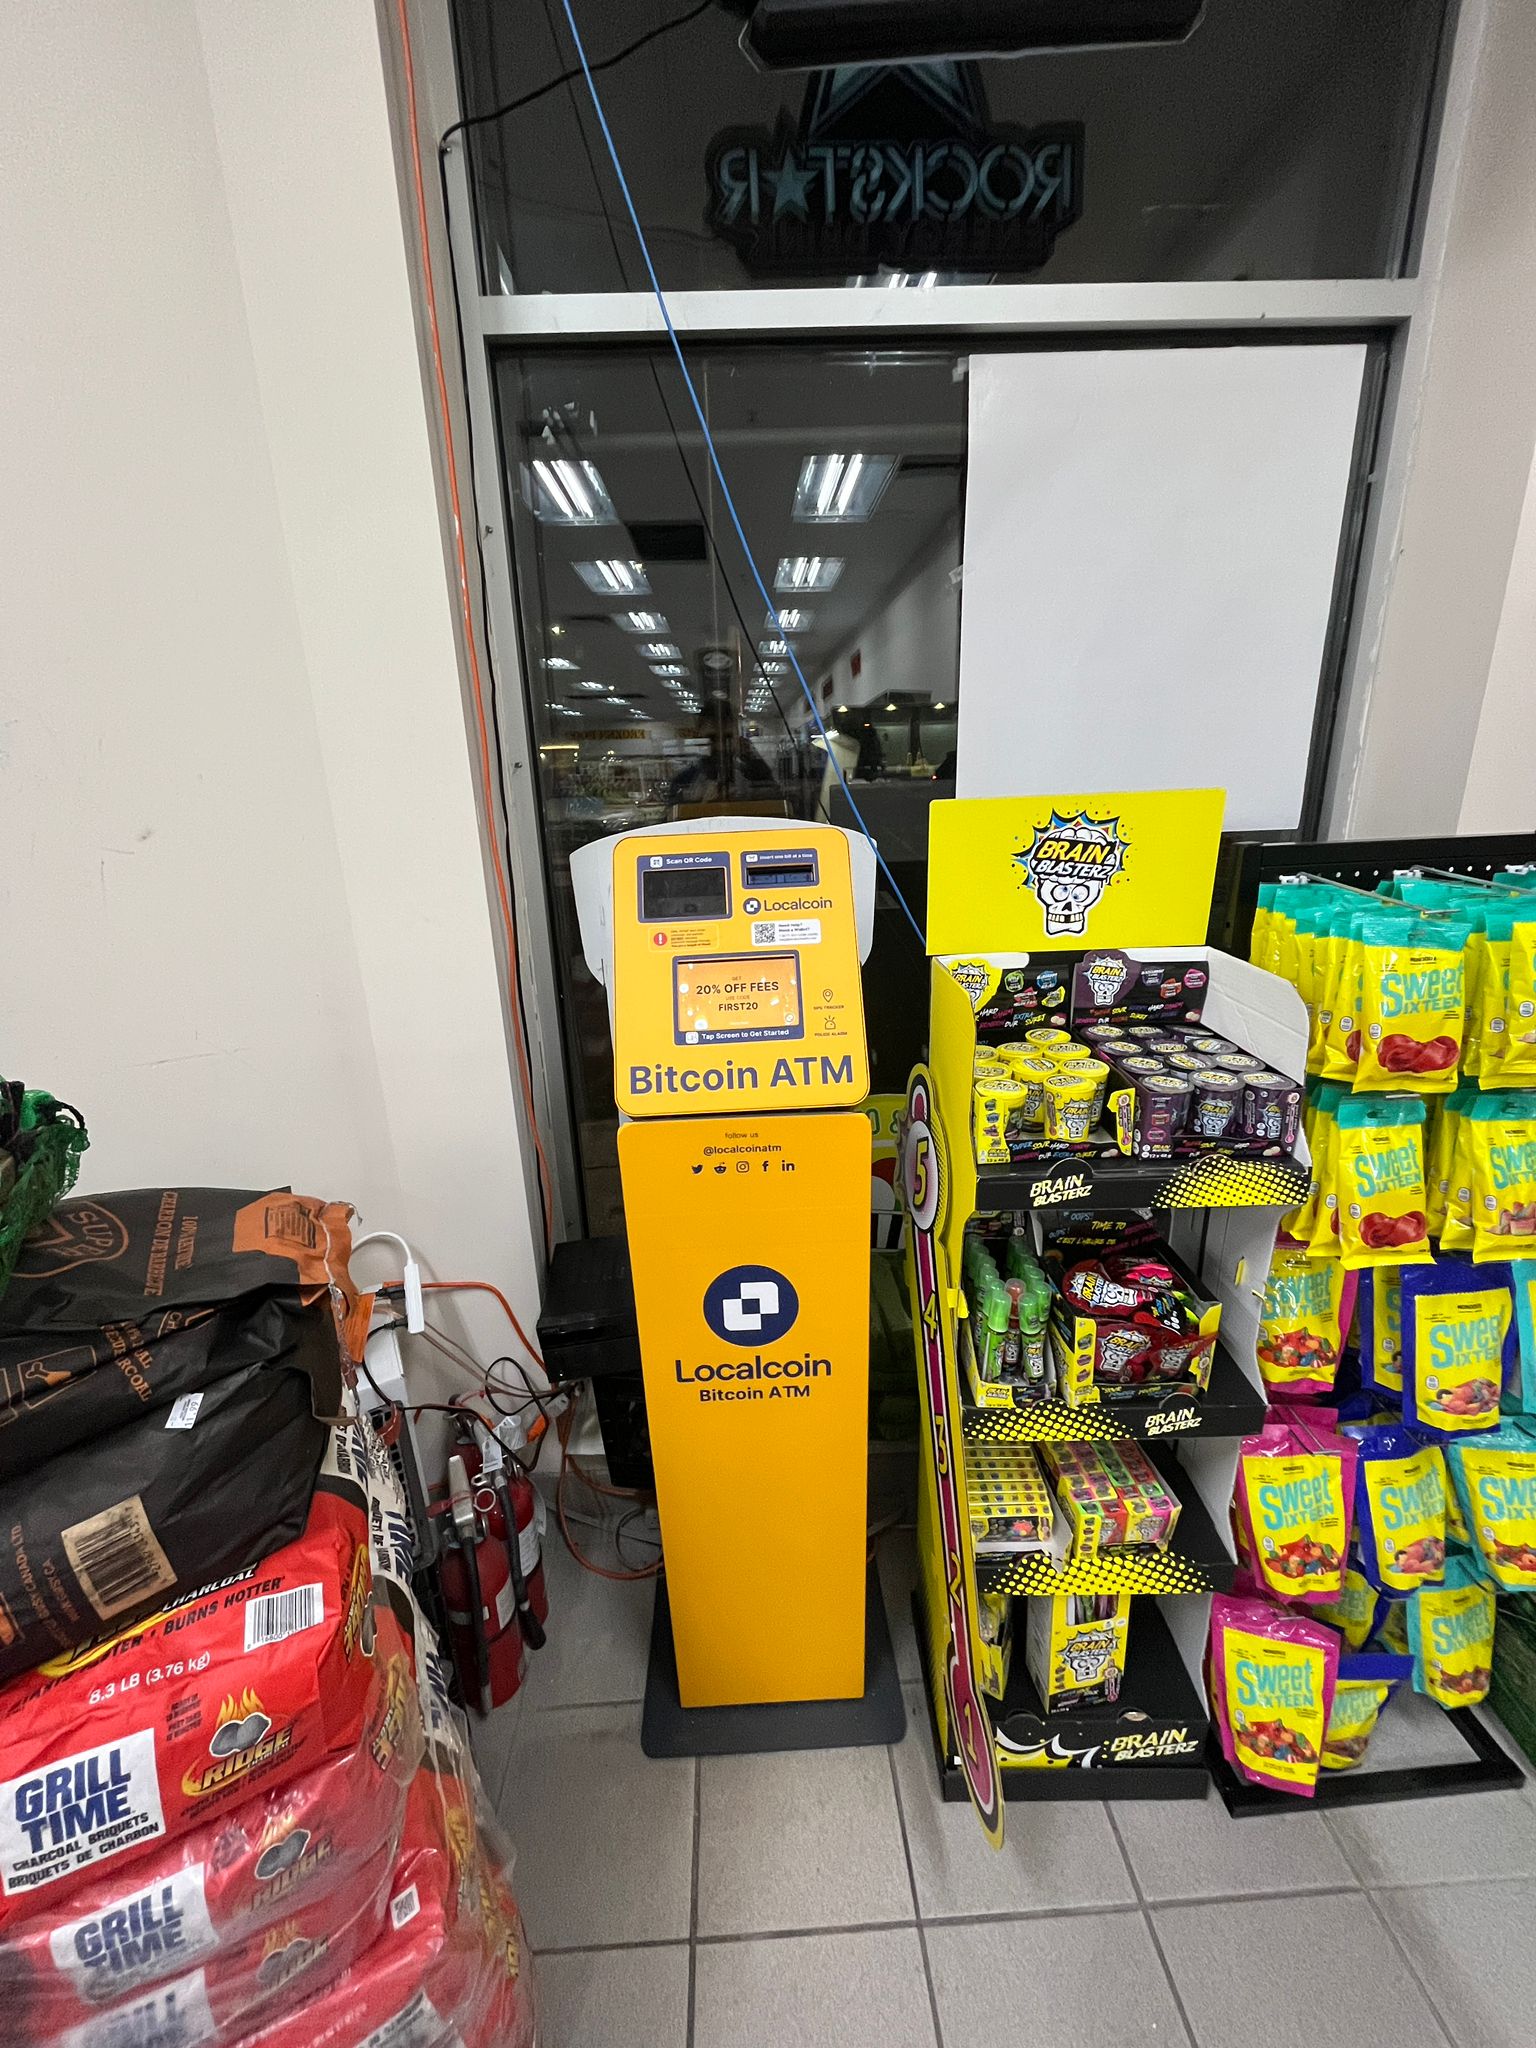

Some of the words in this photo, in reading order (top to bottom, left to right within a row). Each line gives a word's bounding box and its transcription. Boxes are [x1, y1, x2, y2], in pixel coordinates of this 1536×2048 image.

[694, 856, 712, 864] Code
[1036, 840, 1109, 864] BRAIN
[1035, 860, 1114, 879] BLASTERZ
[763, 897, 833, 912] Localcoin
[1092, 965, 1121, 976] BRAIN
[696, 984, 721, 995] 20%
[724, 983, 747, 993] OFF
[750, 981, 779, 992] FEES
[718, 1002, 759, 1011] FIRST20
[702, 1033, 715, 1041] Tap
[716, 1031, 740, 1039] Screen
[764, 1029, 789, 1037] Started
[629, 1060, 758, 1095] Bitcoin
[770, 1055, 853, 1088] ATM
[703, 1143, 782, 1156] @localcoinatm
[1032, 1141, 1051, 1150] SOUR
[913, 1136, 930, 1206] 5
[1490, 1141, 1536, 1190] Swe
[1030, 1173, 1084, 1197] BRAIN
[1033, 1185, 1093, 1207] BLASTERZ
[1092, 1221, 1113, 1231] TIME
[1116, 1222, 1127, 1230] TO
[1081, 1273, 1098, 1301] BRAIN
[923, 1291, 937, 1340] 4
[675, 1353, 831, 1383] Localcoin
[700, 1387, 764, 1402] Bitcoin
[769, 1385, 810, 1398] ATM
[184, 1400, 200, 1427] 11.99
[1145, 1407, 1195, 1428] BRAIN
[1148, 1417, 1202, 1437] BLASTERZ
[935, 1415, 948, 1475] 3
[163, 1601, 219, 1636] BURNS
[223, 1575, 286, 1608] HOTTER
[1070, 1640, 1110, 1652] BRAIN
[89, 1683, 117, 1704] 8.3
[120, 1672, 140, 1691] LB
[146, 1661, 184, 1686] (3.76
[187, 1651, 211, 1672] kg)
[1110, 1727, 1188, 1752] BRAIN
[1114, 1740, 1199, 1761] BLASTERZ
[200, 1725, 293, 1790] RIDGE
[15, 1748, 131, 1823] GRILL
[21, 1783, 133, 1854] TIME
[12, 1840, 84, 1872] CHARCOAL
[88, 1813, 149, 1845] BRIQUETS
[8, 1861, 70, 1890] BRIQUETS
[76, 1849, 93, 1864] DE
[99, 1822, 160, 1855] CHARBON
[74, 1884, 184, 1960] GRILL
